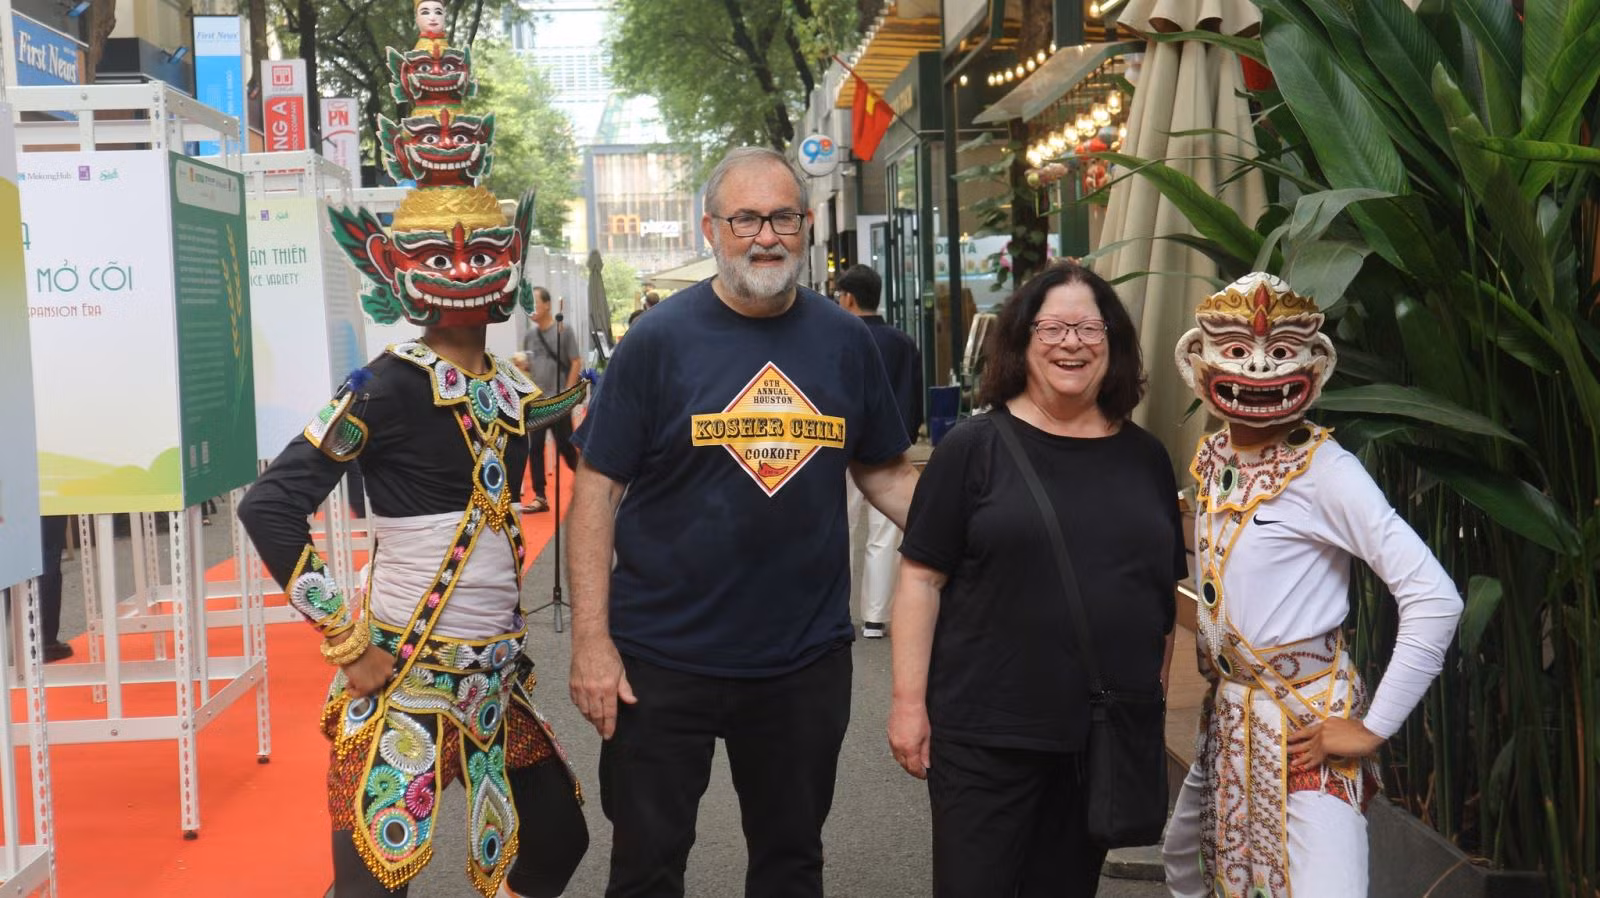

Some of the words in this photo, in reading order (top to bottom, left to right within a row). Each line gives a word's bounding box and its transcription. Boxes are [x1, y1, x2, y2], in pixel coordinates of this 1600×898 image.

[197, 31, 214, 40] First
[18, 31, 46, 71] First
[47, 43, 77, 84] News
[271, 101, 289, 116] A
[271, 120, 289, 149] NG
[37, 259, 79, 293] MỞ
[89, 260, 133, 292] CÕI
[250, 273, 263, 287] ICE
[266, 272, 299, 287] VARIETY
[29, 305, 78, 318] PANSION
[763, 379, 780, 387] 6TH
[756, 388, 789, 396] ANNUAL
[753, 396, 793, 404] HOUSTON
[694, 417, 785, 440] KOSHER
[790, 417, 844, 442] CHILI
[745, 448, 801, 461] COOKOFF
